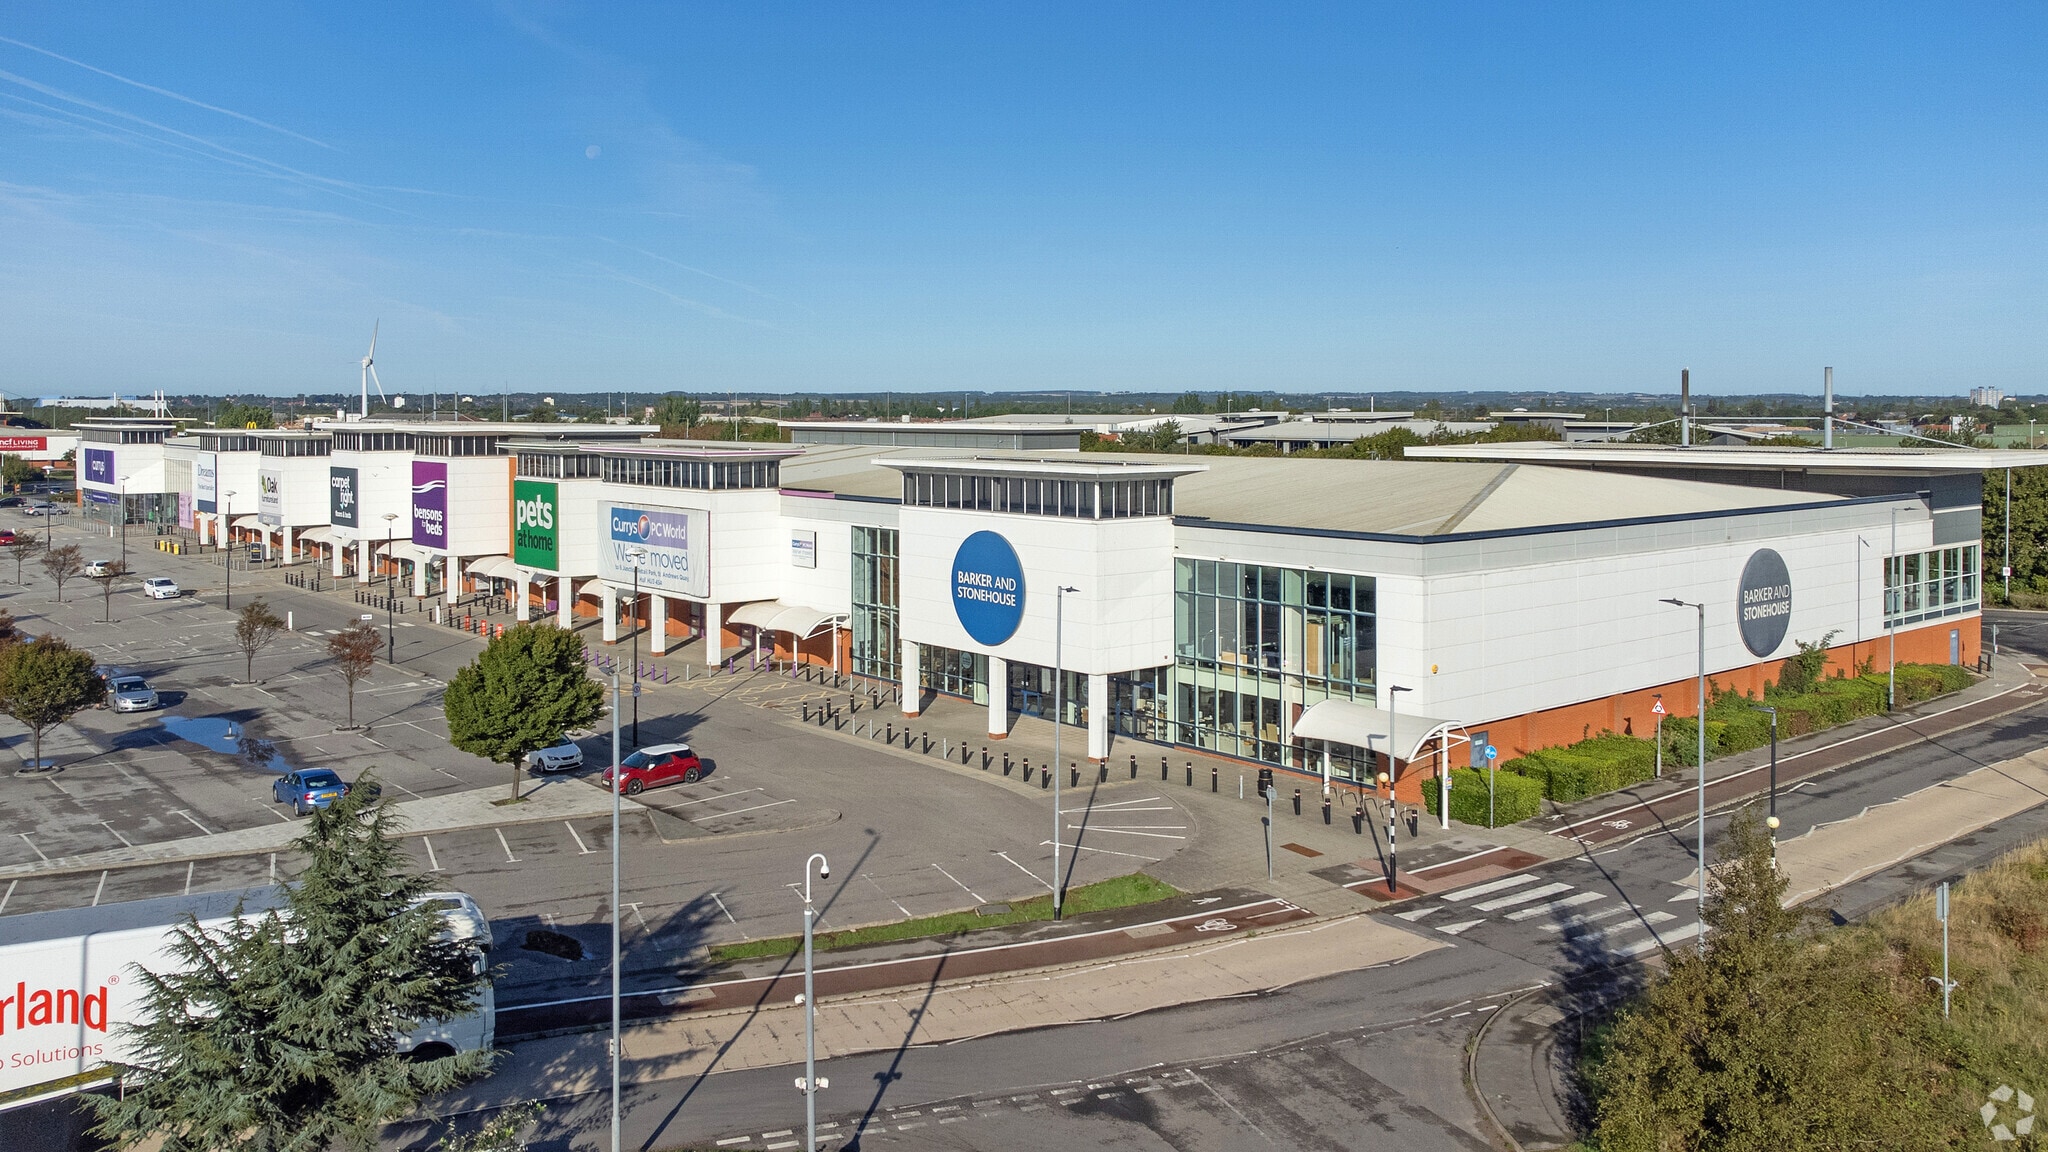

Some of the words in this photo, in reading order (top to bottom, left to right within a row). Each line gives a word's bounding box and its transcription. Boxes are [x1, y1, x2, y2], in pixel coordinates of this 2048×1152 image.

[267, 477, 278, 493] Oak
[332, 476, 350, 491] carpet
[414, 504, 443, 521] bensons
[516, 494, 553, 531] pets
[426, 520, 443, 536] beds
[613, 517, 638, 536] Currys
[651, 522, 662, 537] PC
[663, 523, 686, 540] World
[518, 530, 527, 548] at
[528, 530, 553, 551] home
[651, 552, 688, 571] moved
[958, 571, 992, 588] BARKER
[994, 576, 1016, 591] AND
[958, 586, 1016, 607] STONEHOUSE
[1744, 586, 1773, 604] BARKER
[1774, 584, 1790, 599] AND
[1744, 600, 1790, 620] STONEHOUSE
[11, 1043, 103, 1069] Solutions
